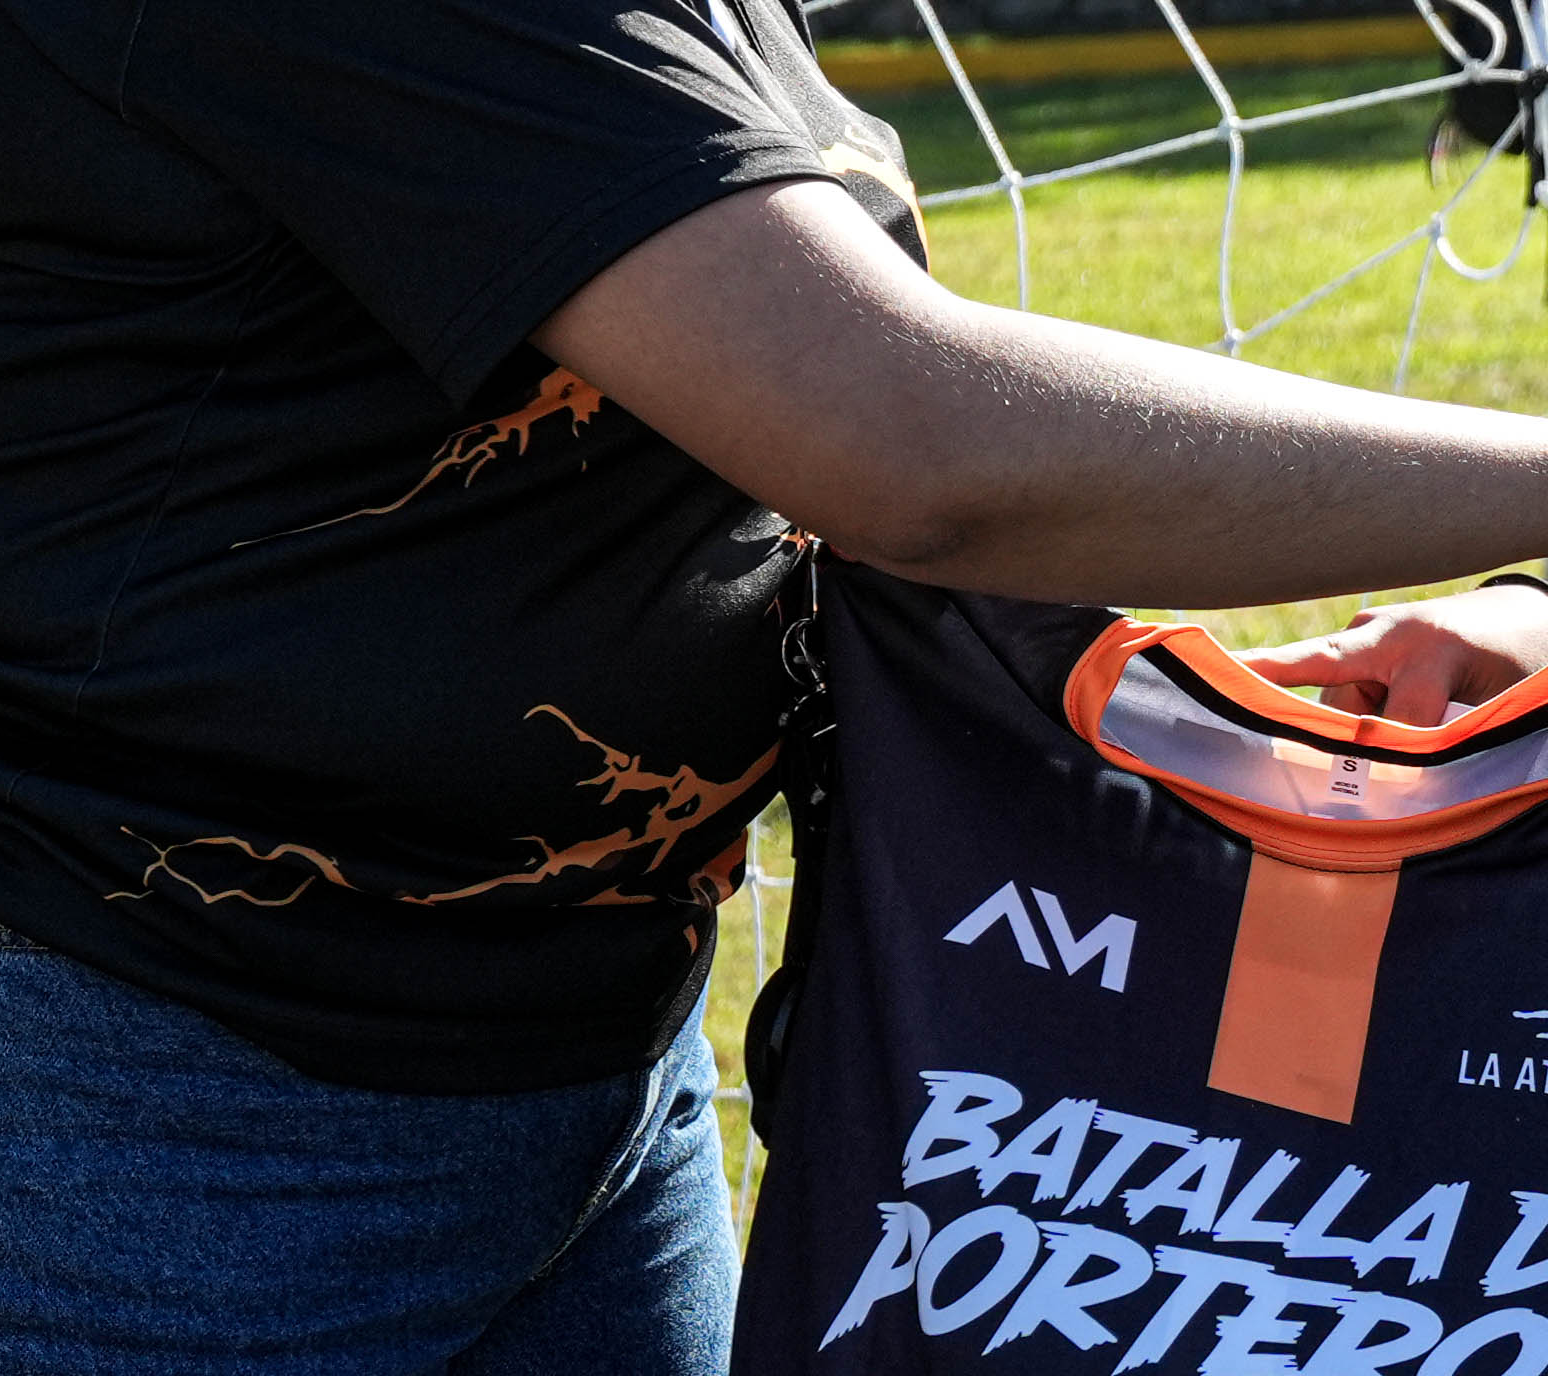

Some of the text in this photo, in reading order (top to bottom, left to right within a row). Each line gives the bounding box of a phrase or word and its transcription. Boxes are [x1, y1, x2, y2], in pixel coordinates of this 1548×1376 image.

[1342, 759, 1358, 772] S
[1457, 1050, 1501, 1088] LA
[901, 1070, 1470, 1286] BATALLA
